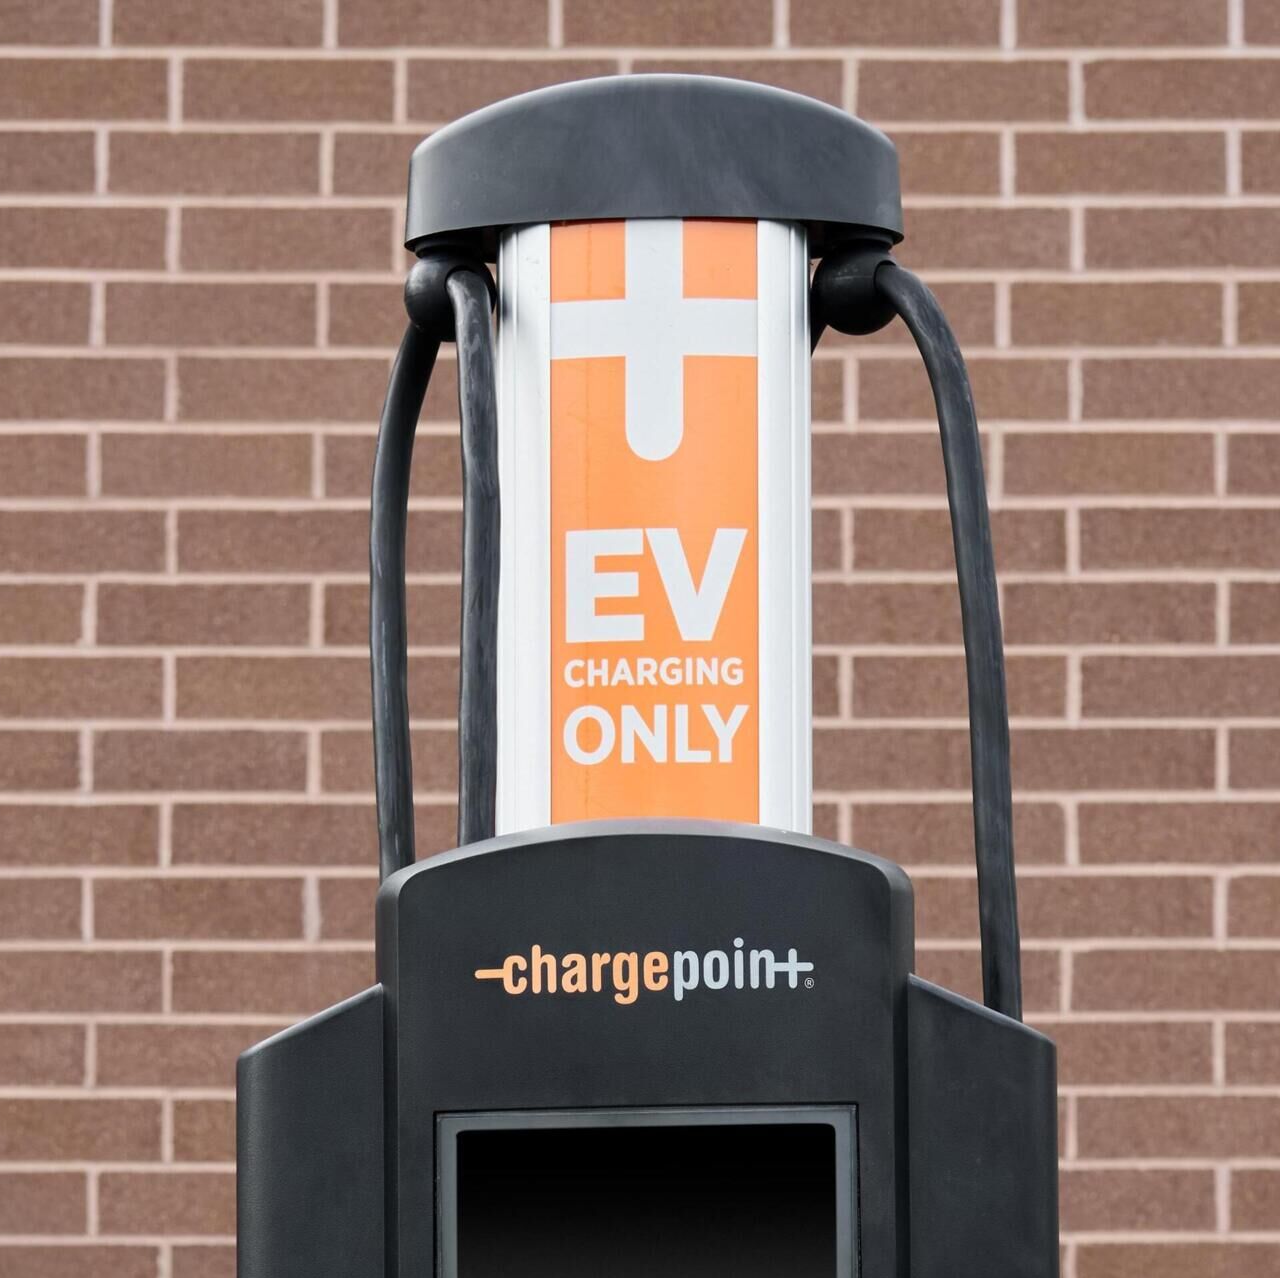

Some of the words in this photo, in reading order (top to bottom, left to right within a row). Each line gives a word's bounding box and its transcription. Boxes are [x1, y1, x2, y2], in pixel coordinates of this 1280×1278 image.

[564, 527, 749, 644] EV
[563, 656, 745, 689] CHARGING
[562, 703, 750, 766] ONLY
